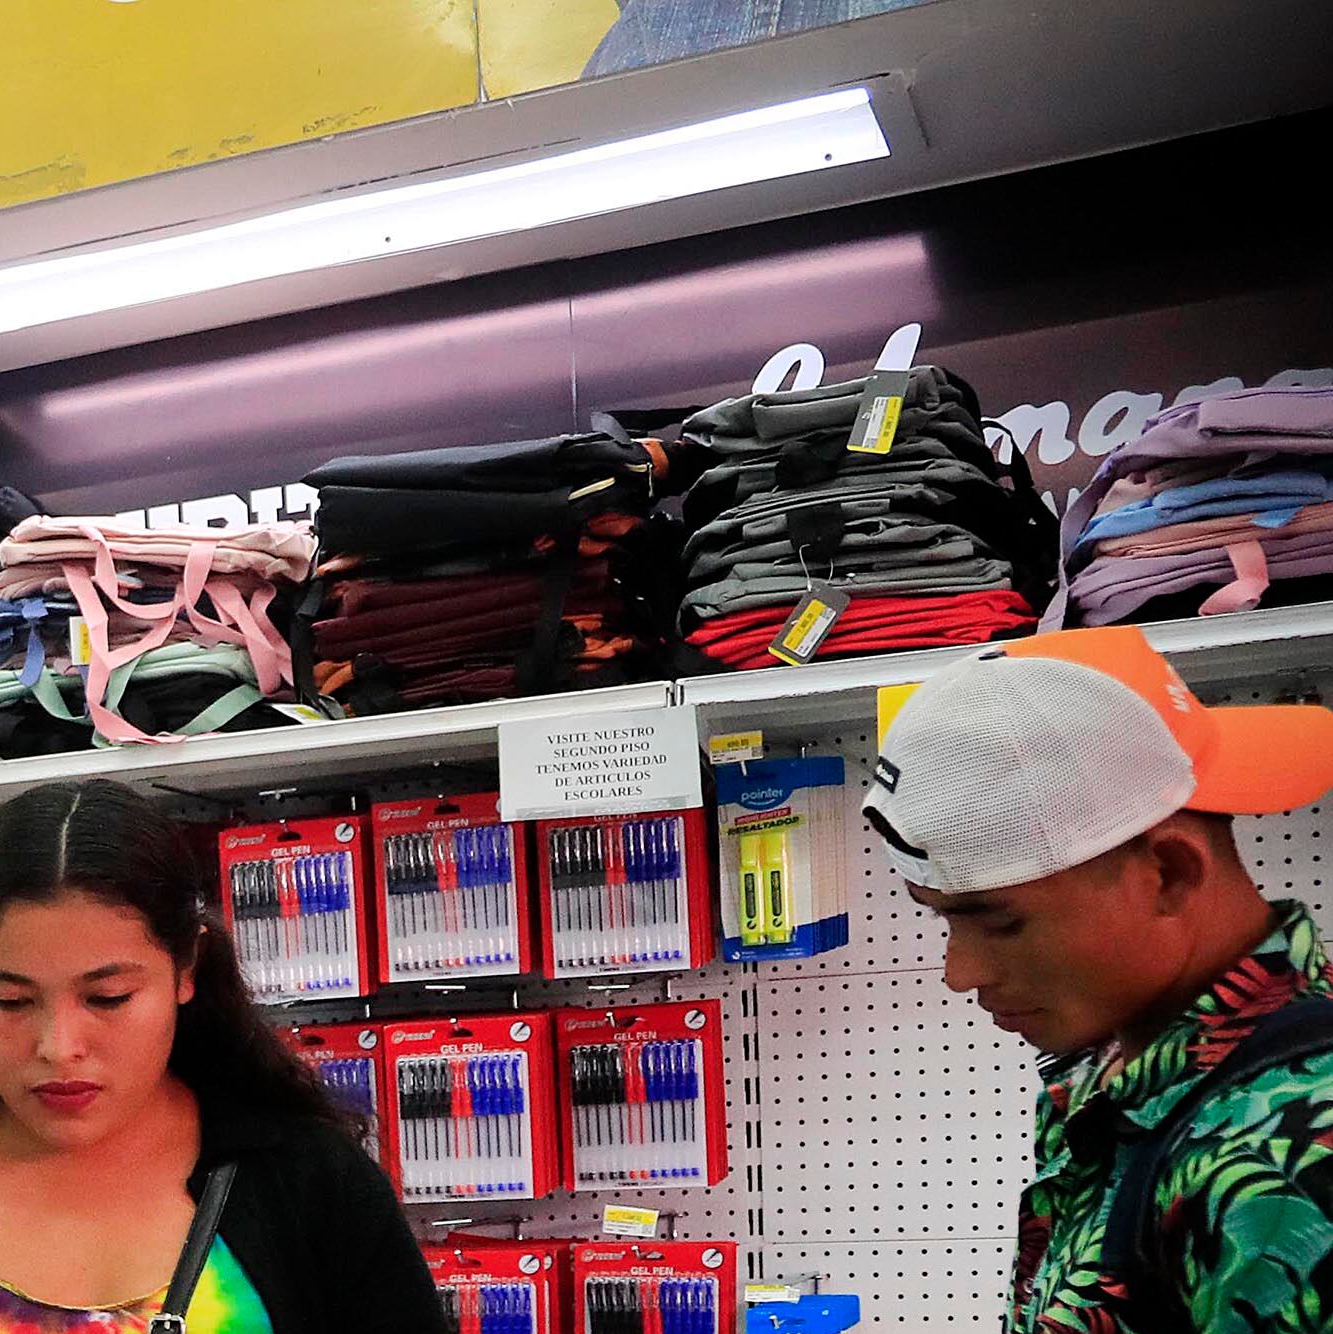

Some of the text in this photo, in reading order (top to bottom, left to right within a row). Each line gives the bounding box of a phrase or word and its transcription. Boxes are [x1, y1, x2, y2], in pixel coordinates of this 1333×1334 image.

[548, 726, 654, 745] VISITE NUESTRO
[553, 741, 649, 759] SEGUNDO PISO
[535, 754, 667, 775] TENEMOS VARIEDAD
[555, 770, 652, 788] DE ARTICULOS
[564, 785, 643, 801] ESCOLARES
[440, 1042, 483, 1054] GEL PEN
[449, 1274, 491, 1283] GEL PEN
[630, 1266, 674, 1276] GEL PEN
